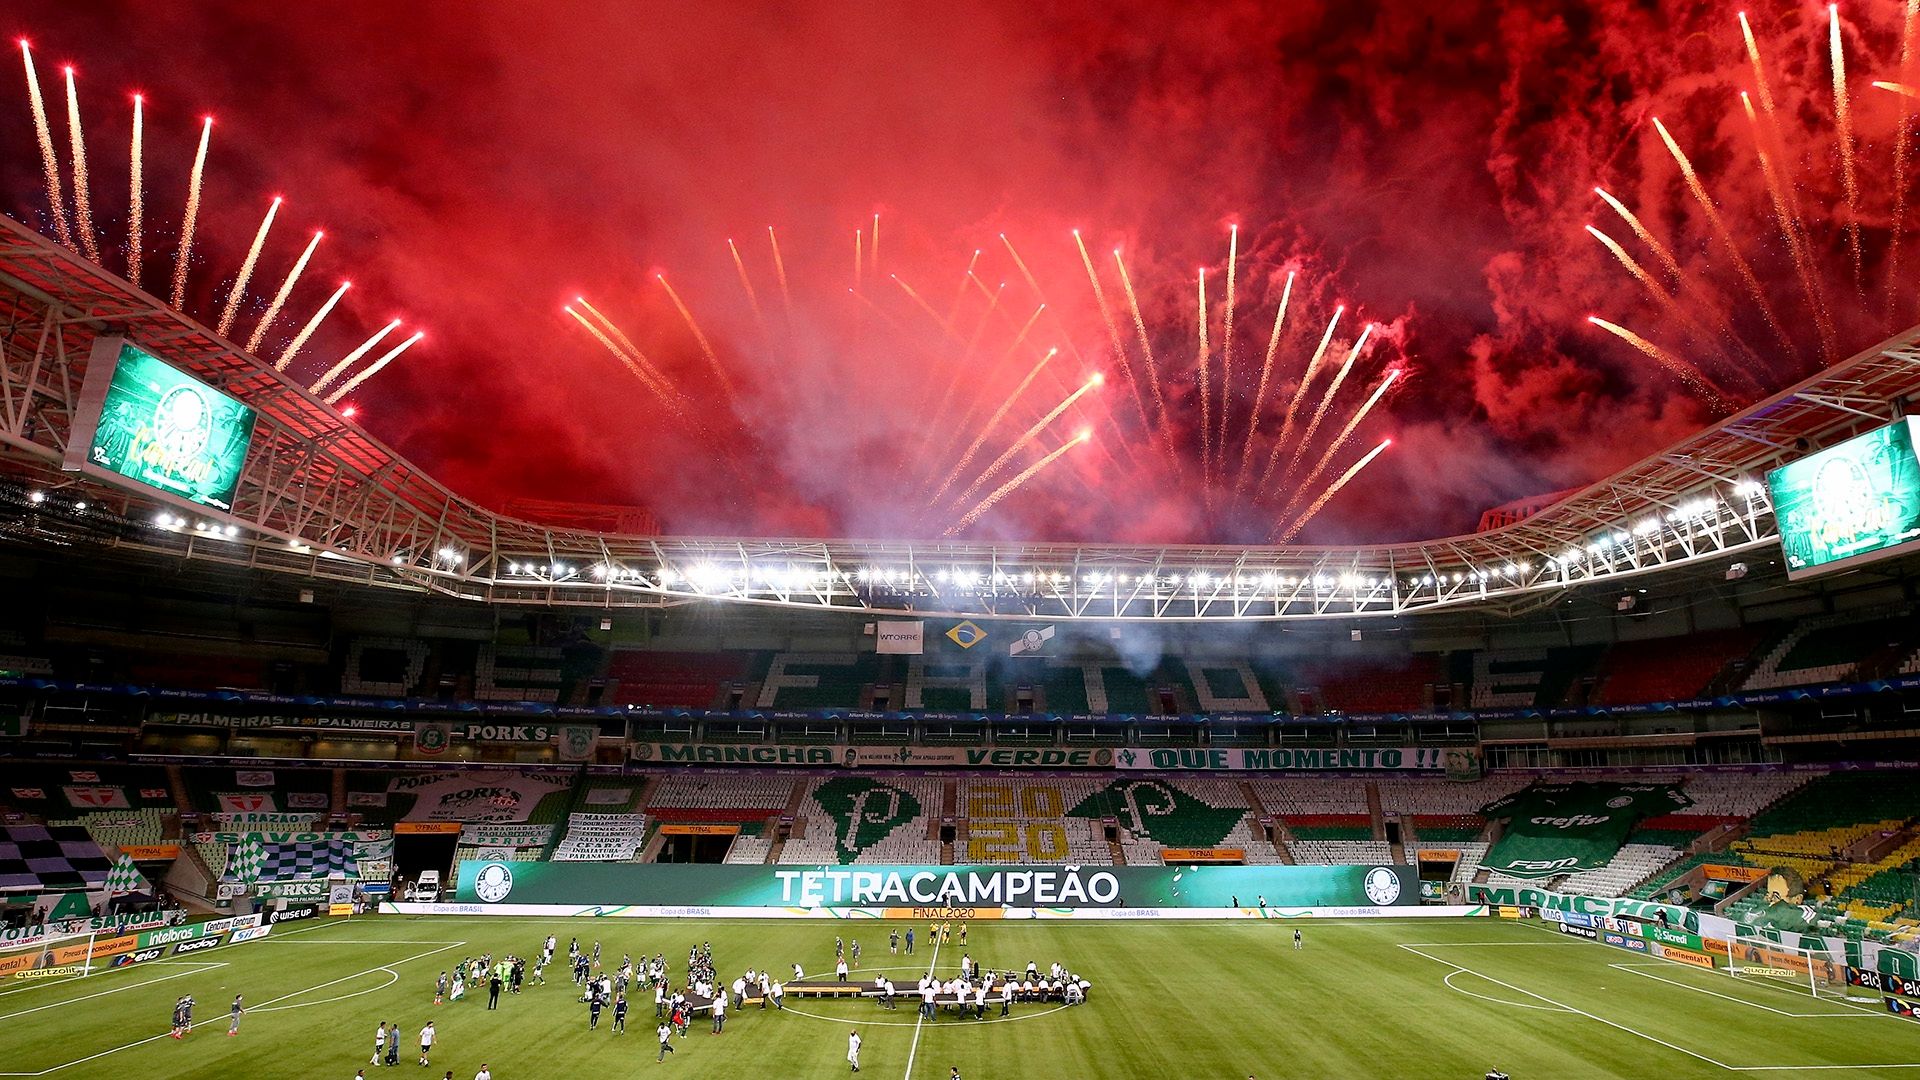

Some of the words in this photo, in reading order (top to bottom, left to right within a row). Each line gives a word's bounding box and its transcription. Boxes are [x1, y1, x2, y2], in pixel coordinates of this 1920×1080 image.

[176, 712, 285, 728] PALMEIRAS
[317, 717, 411, 729] PALMEIRAS
[467, 724, 548, 742] PORK'S
[660, 745, 833, 763] MANCHA
[967, 749, 1090, 766] VERDE
[1150, 749, 1229, 769] QUE
[1242, 749, 1403, 769] MOMENTO
[967, 823, 1070, 860] 20
[1731, 867, 1751, 877] FINAL
[90, 911, 164, 930] SAVOIA
[280, 911, 300, 920] WISE
[1543, 909, 1561, 920] MAG
[206, 919, 231, 932] Centrum
[231, 916, 256, 929] Centrum
[0, 924, 45, 940] OIA
[149, 927, 194, 946] intelbras
[1568, 926, 1586, 936] WISE
[1586, 930, 1597, 938] UP
[1662, 931, 1688, 945] Sicredi
[63, 949, 81, 958] Pneus
[90, 942, 118, 953] ecnologia
[1703, 939, 1736, 954] Continenal
[0, 957, 22, 970] ental
[135, 950, 160, 963] elo
[1664, 948, 1704, 965] Continental
[17, 967, 78, 979] quartzolit
[1744, 967, 1796, 976] quartzolit
